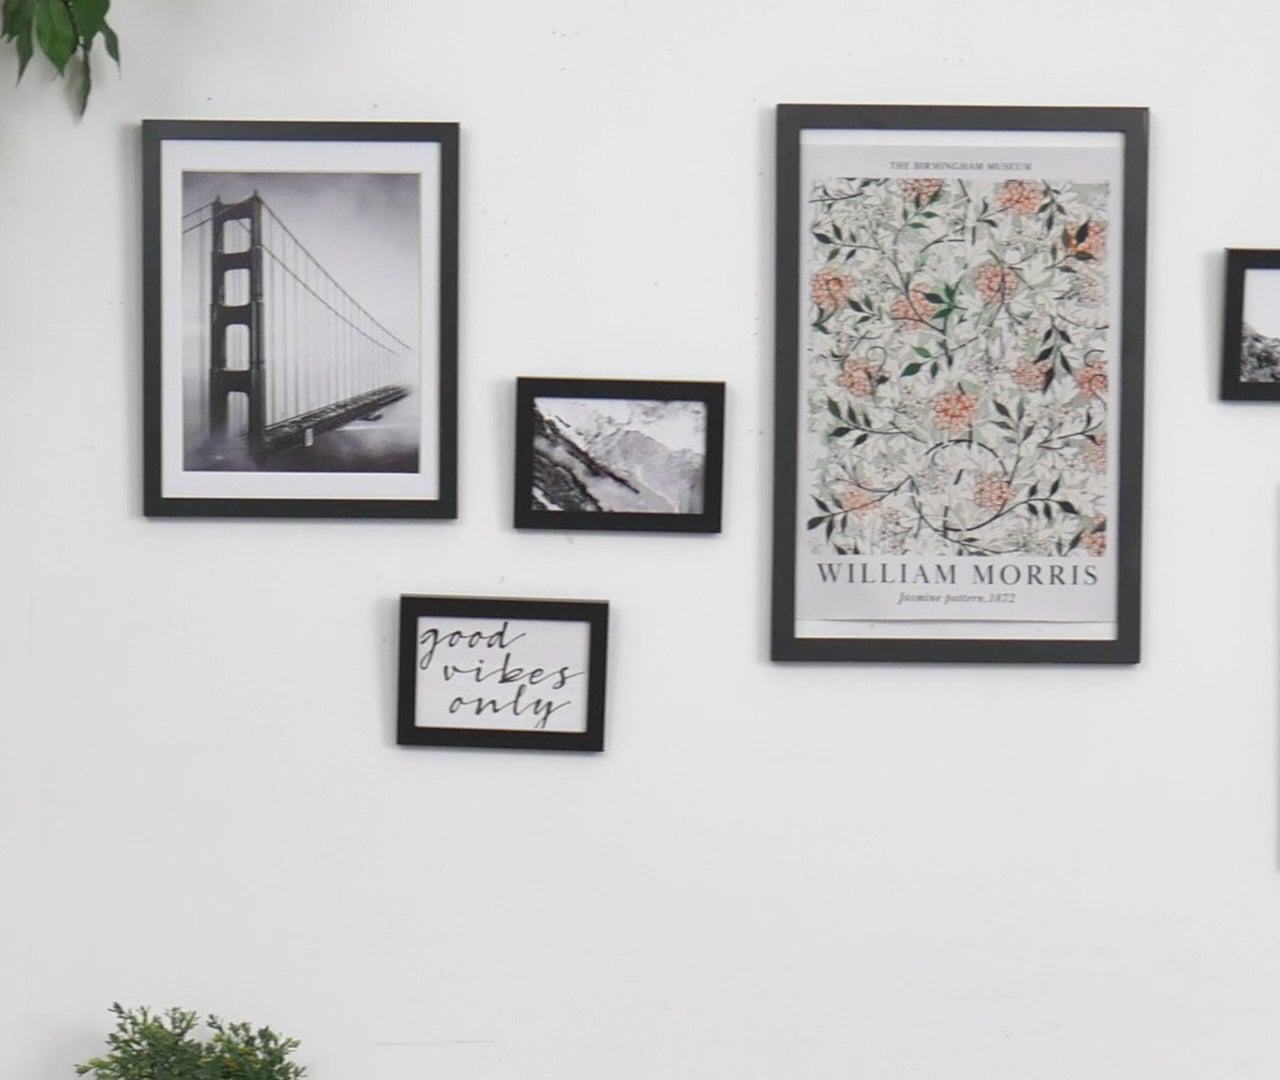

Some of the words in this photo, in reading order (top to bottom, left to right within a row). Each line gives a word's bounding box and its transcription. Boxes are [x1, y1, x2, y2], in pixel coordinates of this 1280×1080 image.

[889, 160, 910, 170] THE
[817, 562, 957, 584] WILLIAM
[972, 564, 1099, 586] MORRIS
[420, 620, 527, 670] good
[444, 652, 585, 690] vibes
[449, 684, 572, 729] only
